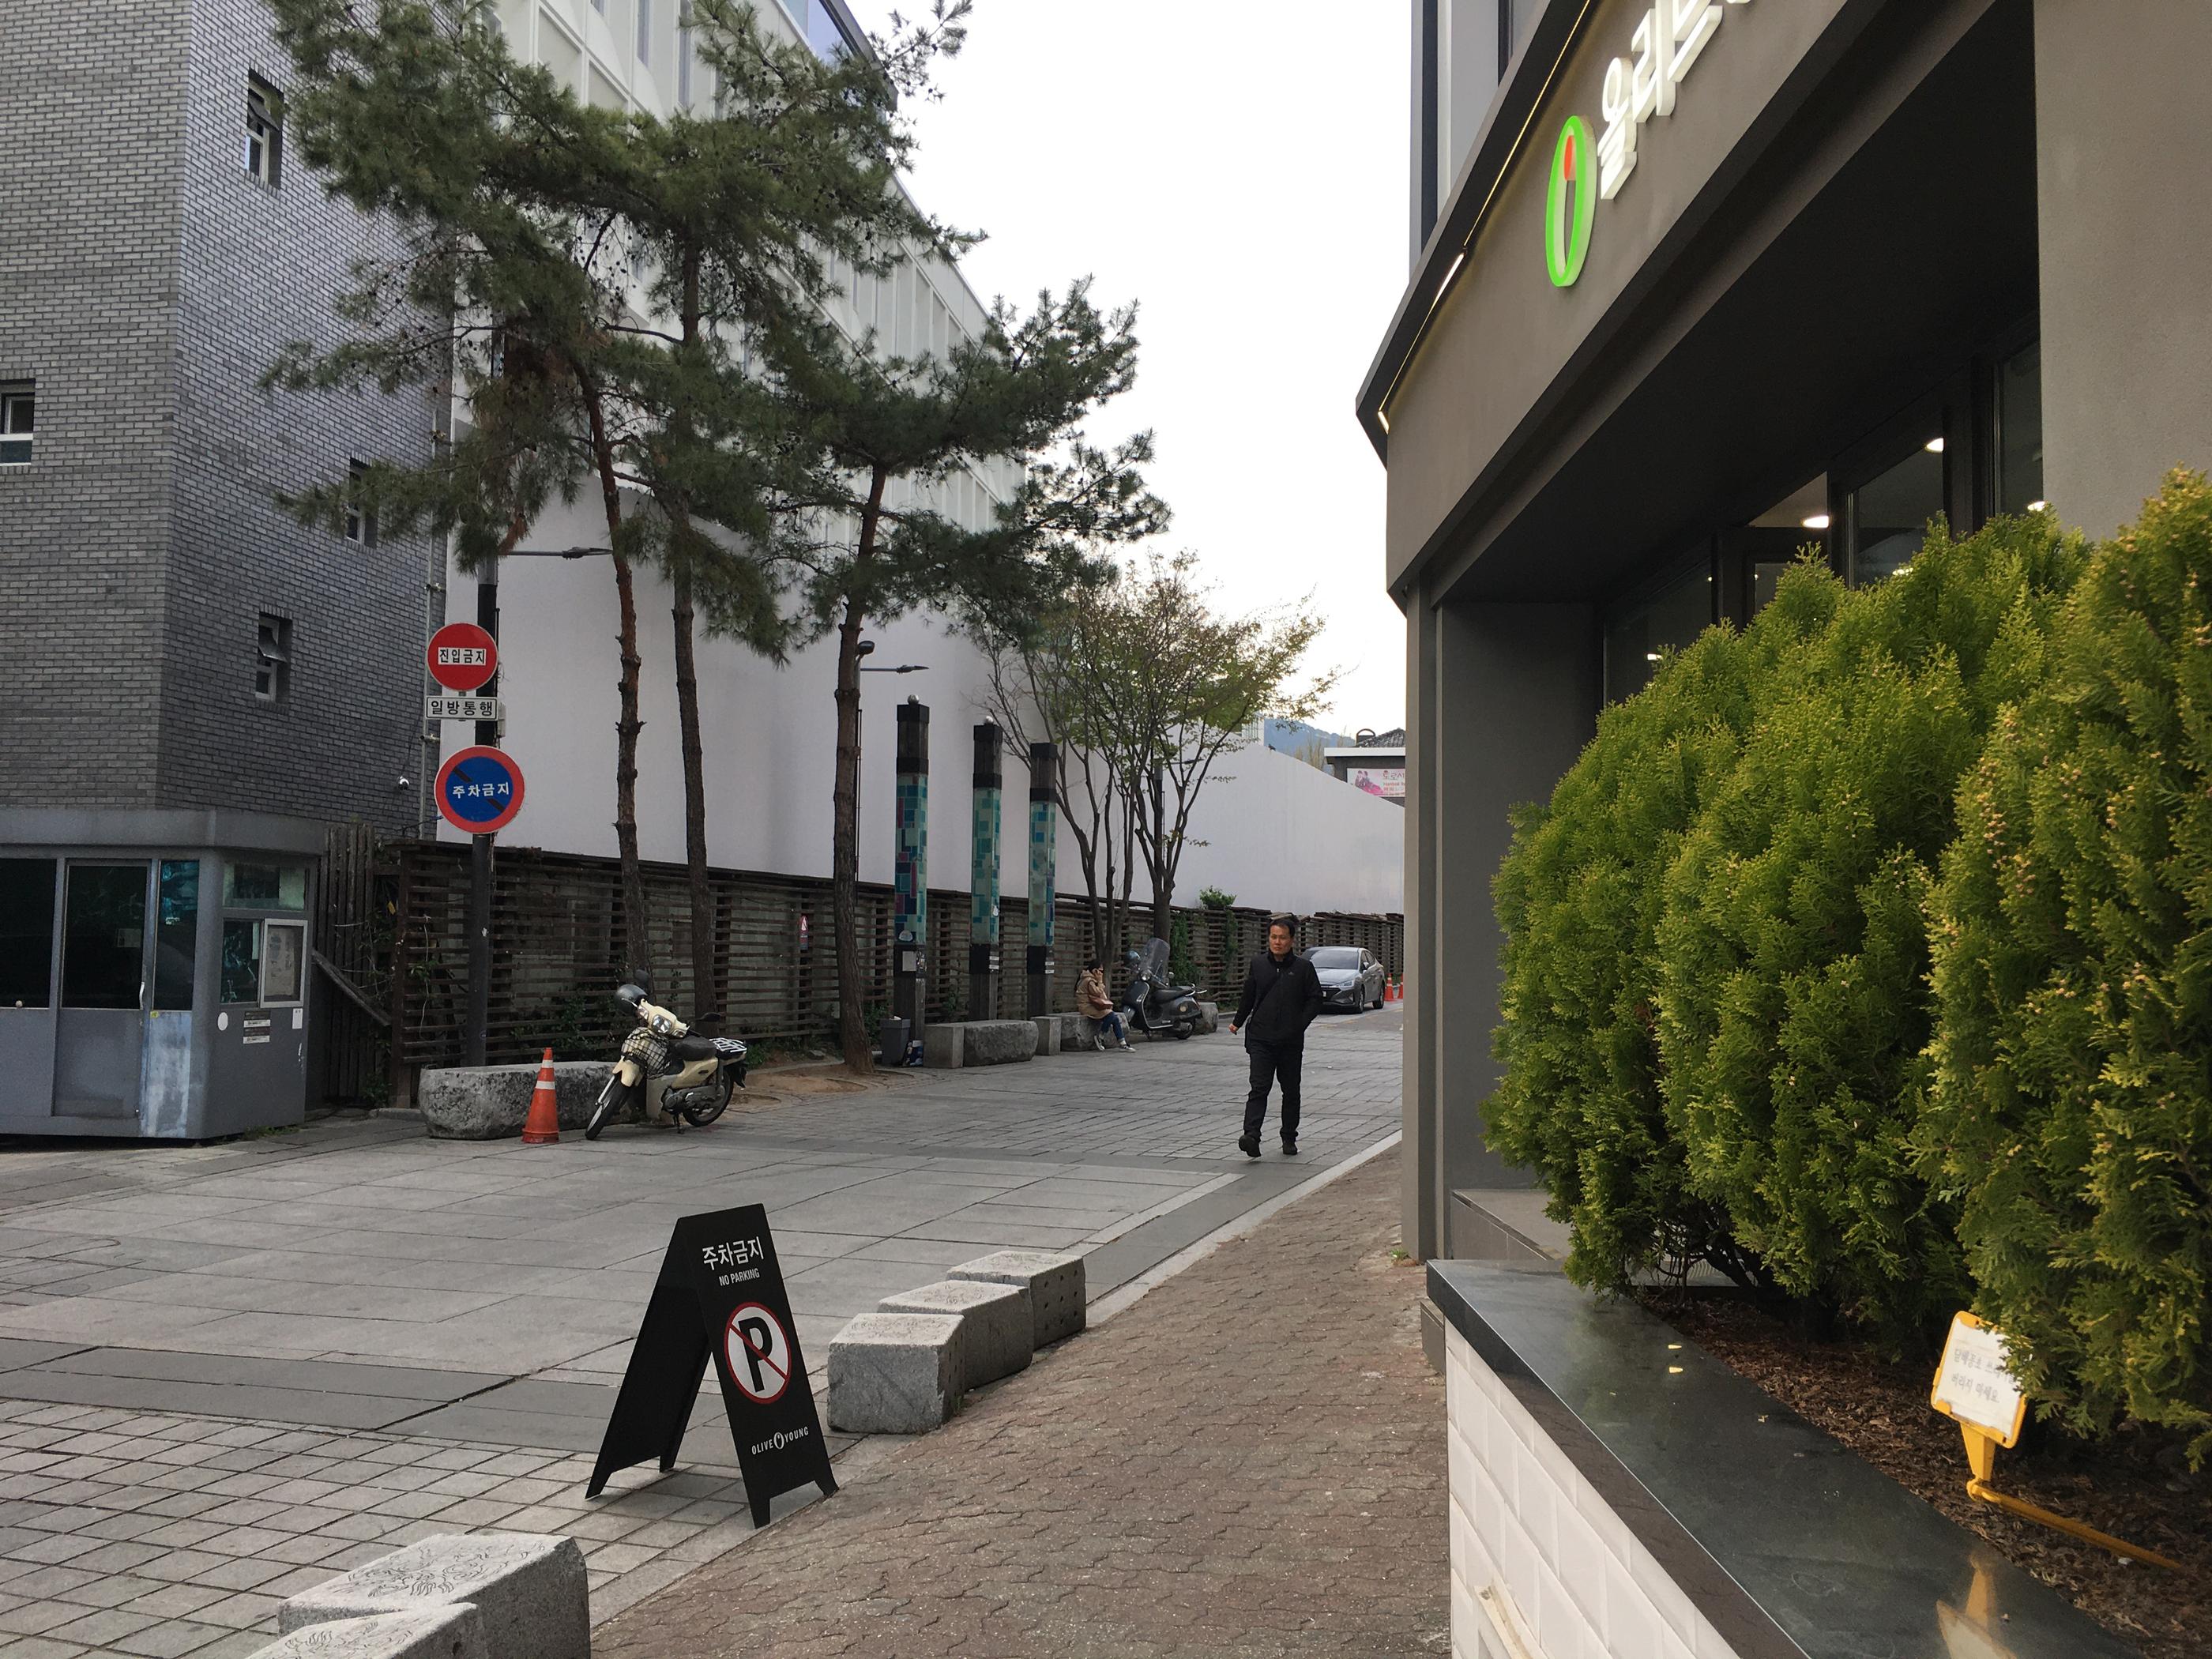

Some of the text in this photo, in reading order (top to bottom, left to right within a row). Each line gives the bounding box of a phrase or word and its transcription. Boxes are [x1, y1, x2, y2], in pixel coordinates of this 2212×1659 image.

[1597, 0, 1751, 199] 올리브
[439, 649, 485, 664] 진입금지
[431, 701, 492, 717] 일방통행
[452, 781, 510, 799] 주차금지
[702, 1236, 764, 1270] 주차금지
[719, 1268, 760, 1286] NO PARKING
